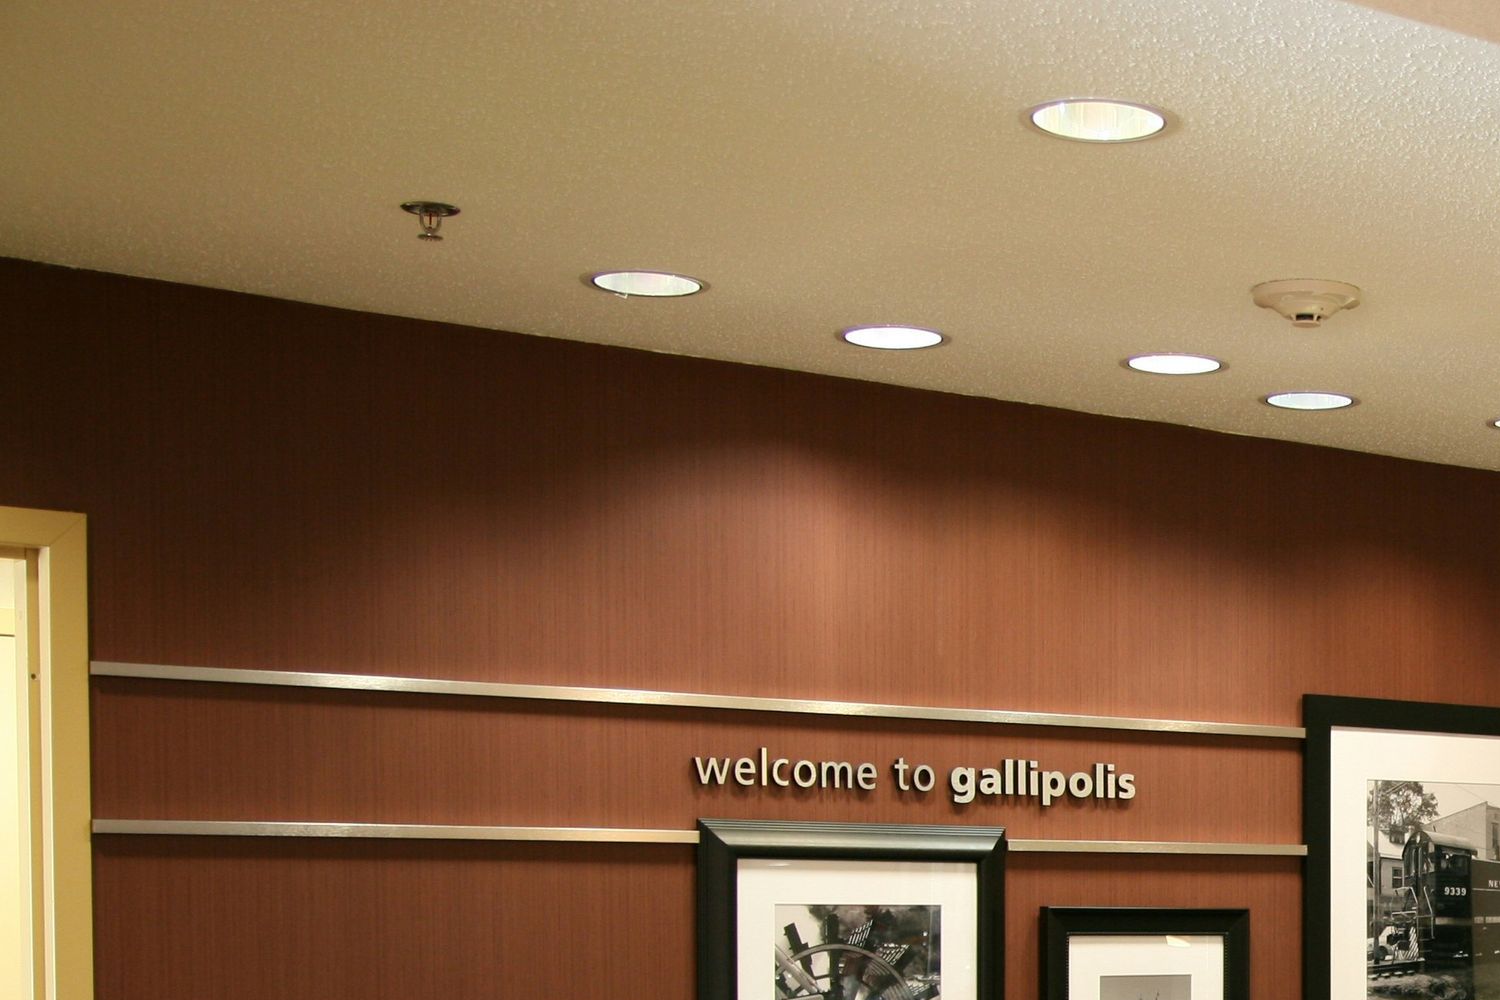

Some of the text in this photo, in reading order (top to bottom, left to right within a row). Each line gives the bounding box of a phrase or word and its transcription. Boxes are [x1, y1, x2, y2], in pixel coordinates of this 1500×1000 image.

[694, 747, 1136, 806] welcome to gallipolis
[1444, 886, 1467, 896] 9339
